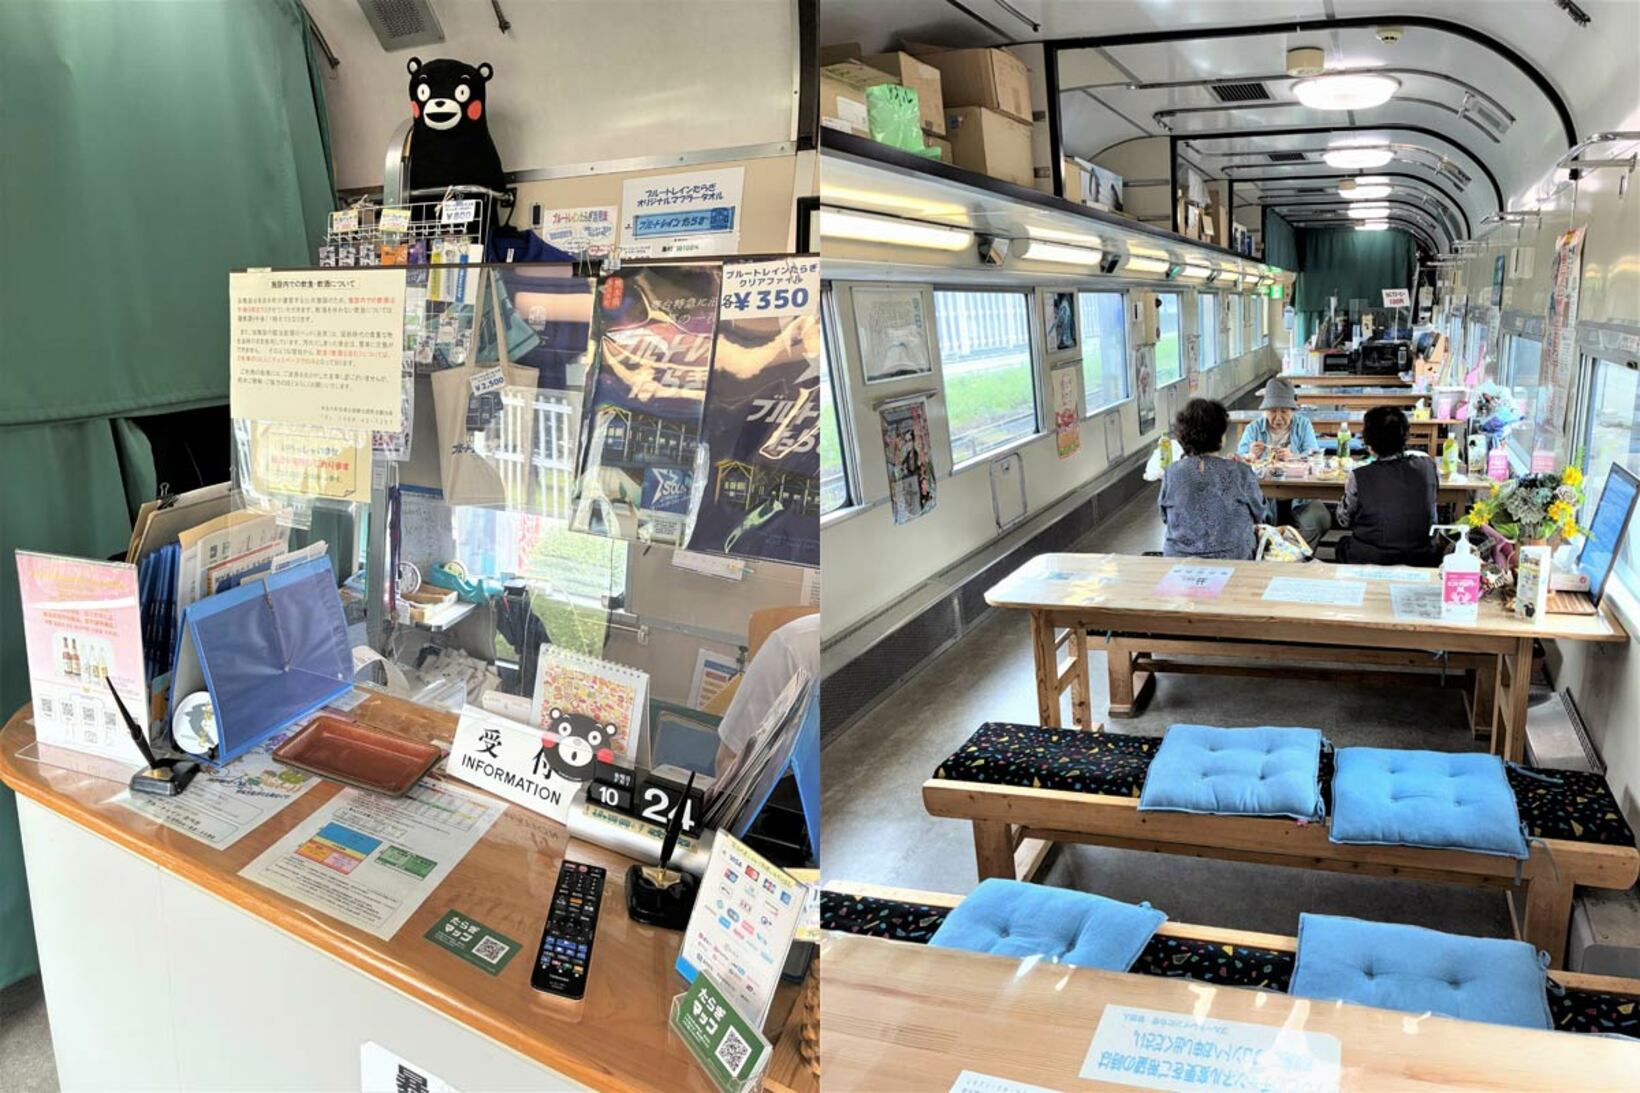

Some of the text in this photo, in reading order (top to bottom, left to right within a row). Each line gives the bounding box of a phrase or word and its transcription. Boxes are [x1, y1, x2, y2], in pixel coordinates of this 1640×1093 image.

[645, 182, 717, 198] ブルートレインたらぎ
[636, 191, 724, 208] オリジナルマフラータオル
[725, 263, 818, 280] ブルートレインたらぎ
[738, 276, 804, 288] クリアファイル
[461, 753, 562, 806] INFORMATION
[599, 786, 619, 806] 10
[642, 787, 695, 832] 24
[448, 916, 481, 935] たらぎ
[697, 987, 727, 1022] たらぎ
